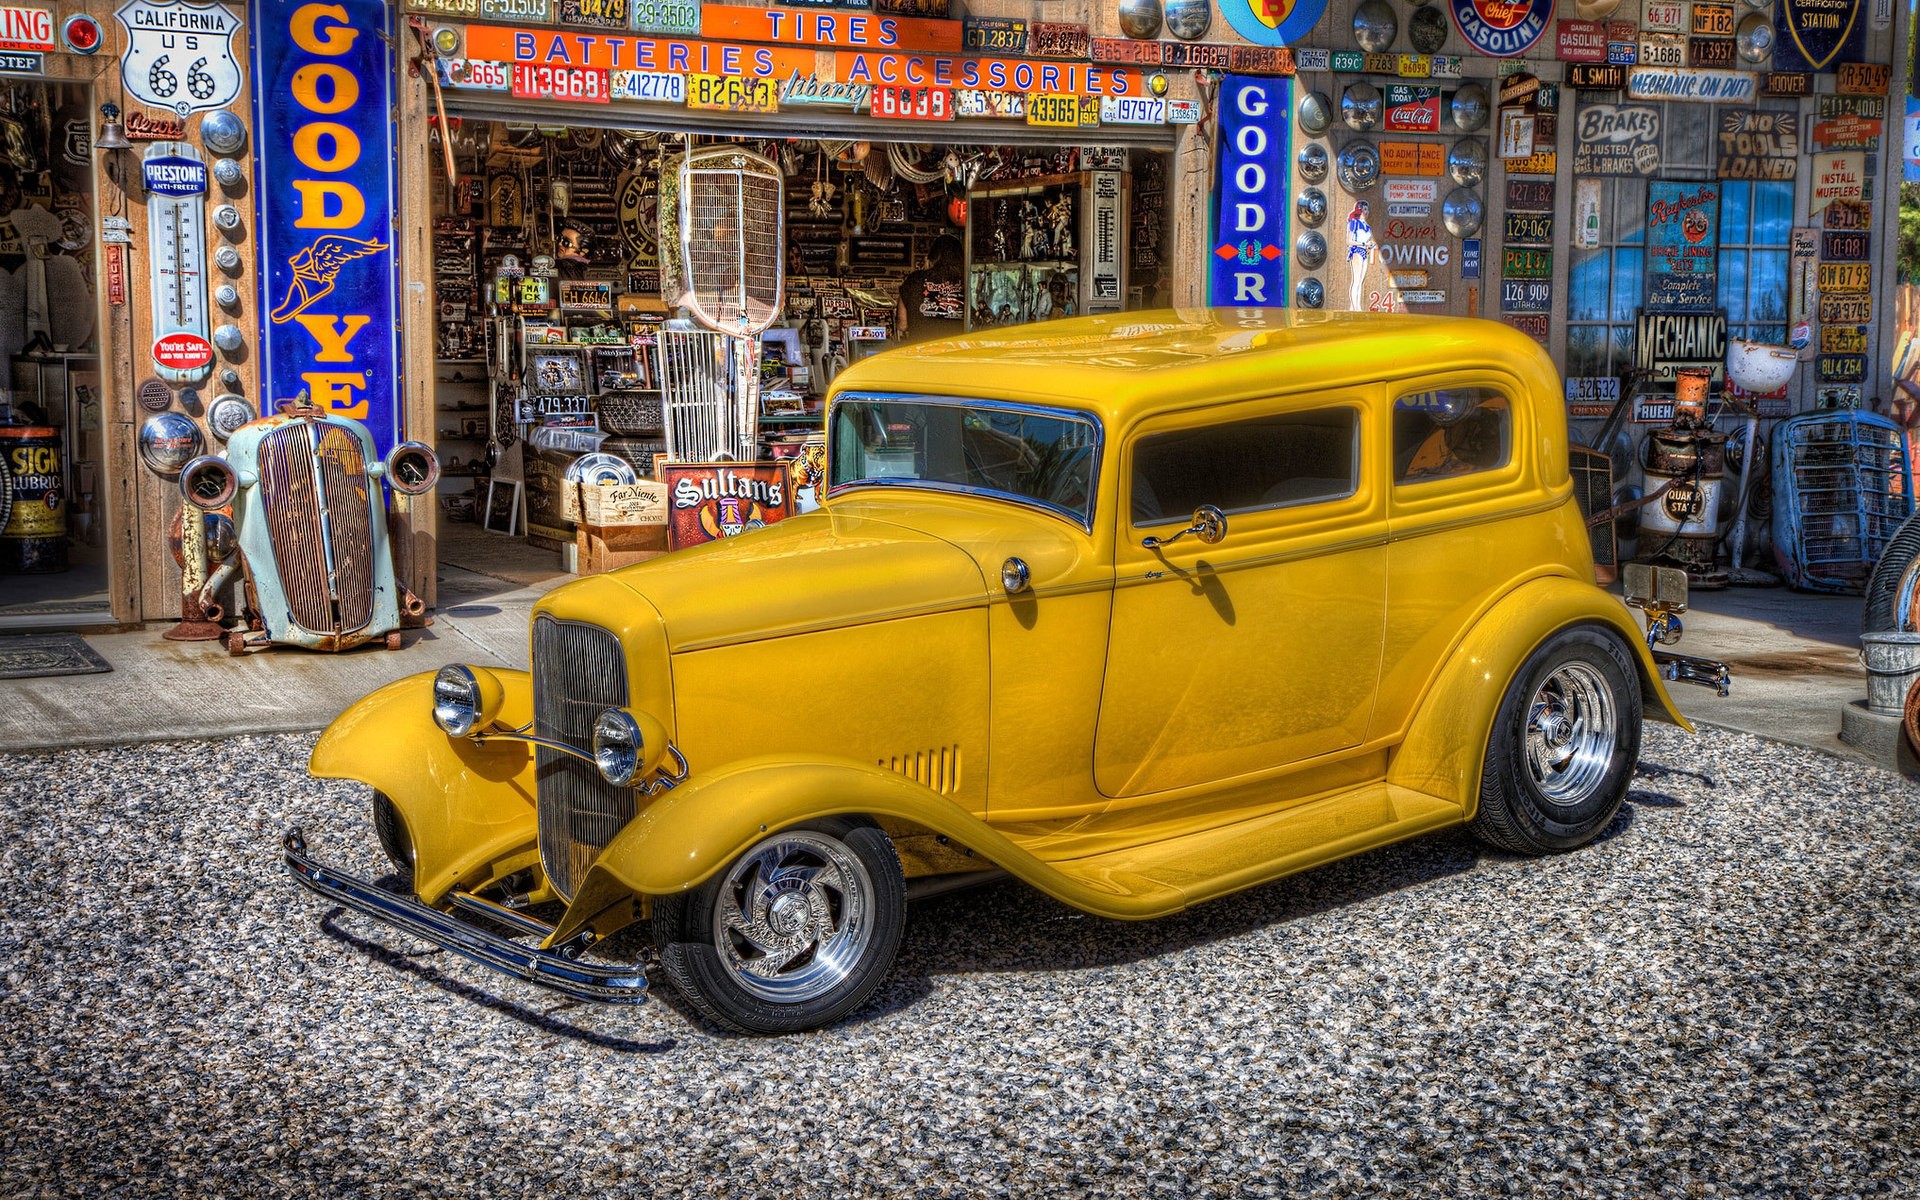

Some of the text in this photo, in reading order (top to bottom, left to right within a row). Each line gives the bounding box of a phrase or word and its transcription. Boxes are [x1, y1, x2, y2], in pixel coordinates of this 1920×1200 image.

[135, 10, 225, 30] CALIFORNIA
[637, 2, 695, 27] 29-3503
[1485, 3, 1527, 26] Chief
[1802, 12, 1840, 28] STATION
[0, 8, 50, 41] ING
[766, 12, 898, 46] TIRES
[1460, 6, 1543, 51] GASOLINE
[990, 30, 1022, 48] 2837
[1560, 34, 1605, 47] GASOLINE
[514, 32, 774, 75] BATTERIES
[1574, 48, 1601, 57] SMOKING
[0, 55, 36, 69] STEP
[150, 54, 215, 99] 66
[850, 54, 1129, 95] ACCESSORIES
[1572, 69, 1621, 86] AL SMITH
[1768, 75, 1805, 92] HOOVER
[627, 74, 681, 98] 412778
[1393, 86, 1408, 94] GAS
[1630, 72, 1755, 98] MECHANIC ON DUTY
[1391, 94, 1412, 103] TODAY
[961, 106, 975, 114] CAL
[1030, 97, 1076, 124] 43365
[1104, 112, 1118, 120] CAL
[1118, 98, 1163, 122] 197972
[1581, 106, 1658, 141] BRAKES
[1743, 113, 1774, 132] NO
[1384, 149, 1393, 158] NO
[1718, 133, 1798, 157] TOOLS
[146, 164, 204, 183] PRESTONE
[1601, 158, 1634, 174] BRAKES
[1717, 156, 1798, 180] LOANED
[1832, 160, 1846, 170] WE
[1821, 173, 1856, 184] INSTALL
[1815, 186, 1861, 199] MUFFLERS
[1398, 206, 1431, 215] ADMITTANCE
[1384, 219, 1438, 240] Dave's
[1368, 244, 1450, 266] TOWING
[1651, 245, 1712, 257] BRAKE LINING
[1504, 284, 1549, 301] 126 909
[1661, 279, 1701, 293] Complete
[1369, 291, 1395, 312] 24
[1650, 293, 1712, 304] Brake Service
[159, 342, 185, 351] YOU'RE
[1636, 315, 1726, 383] MECHANIC
[11, 447, 62, 475] SIGN
[609, 486, 660, 503] Far Niente
[675, 468, 783, 509] Sultans
[1668, 489, 1701, 502] QUAKR
[1671, 502, 1697, 514] STAE
